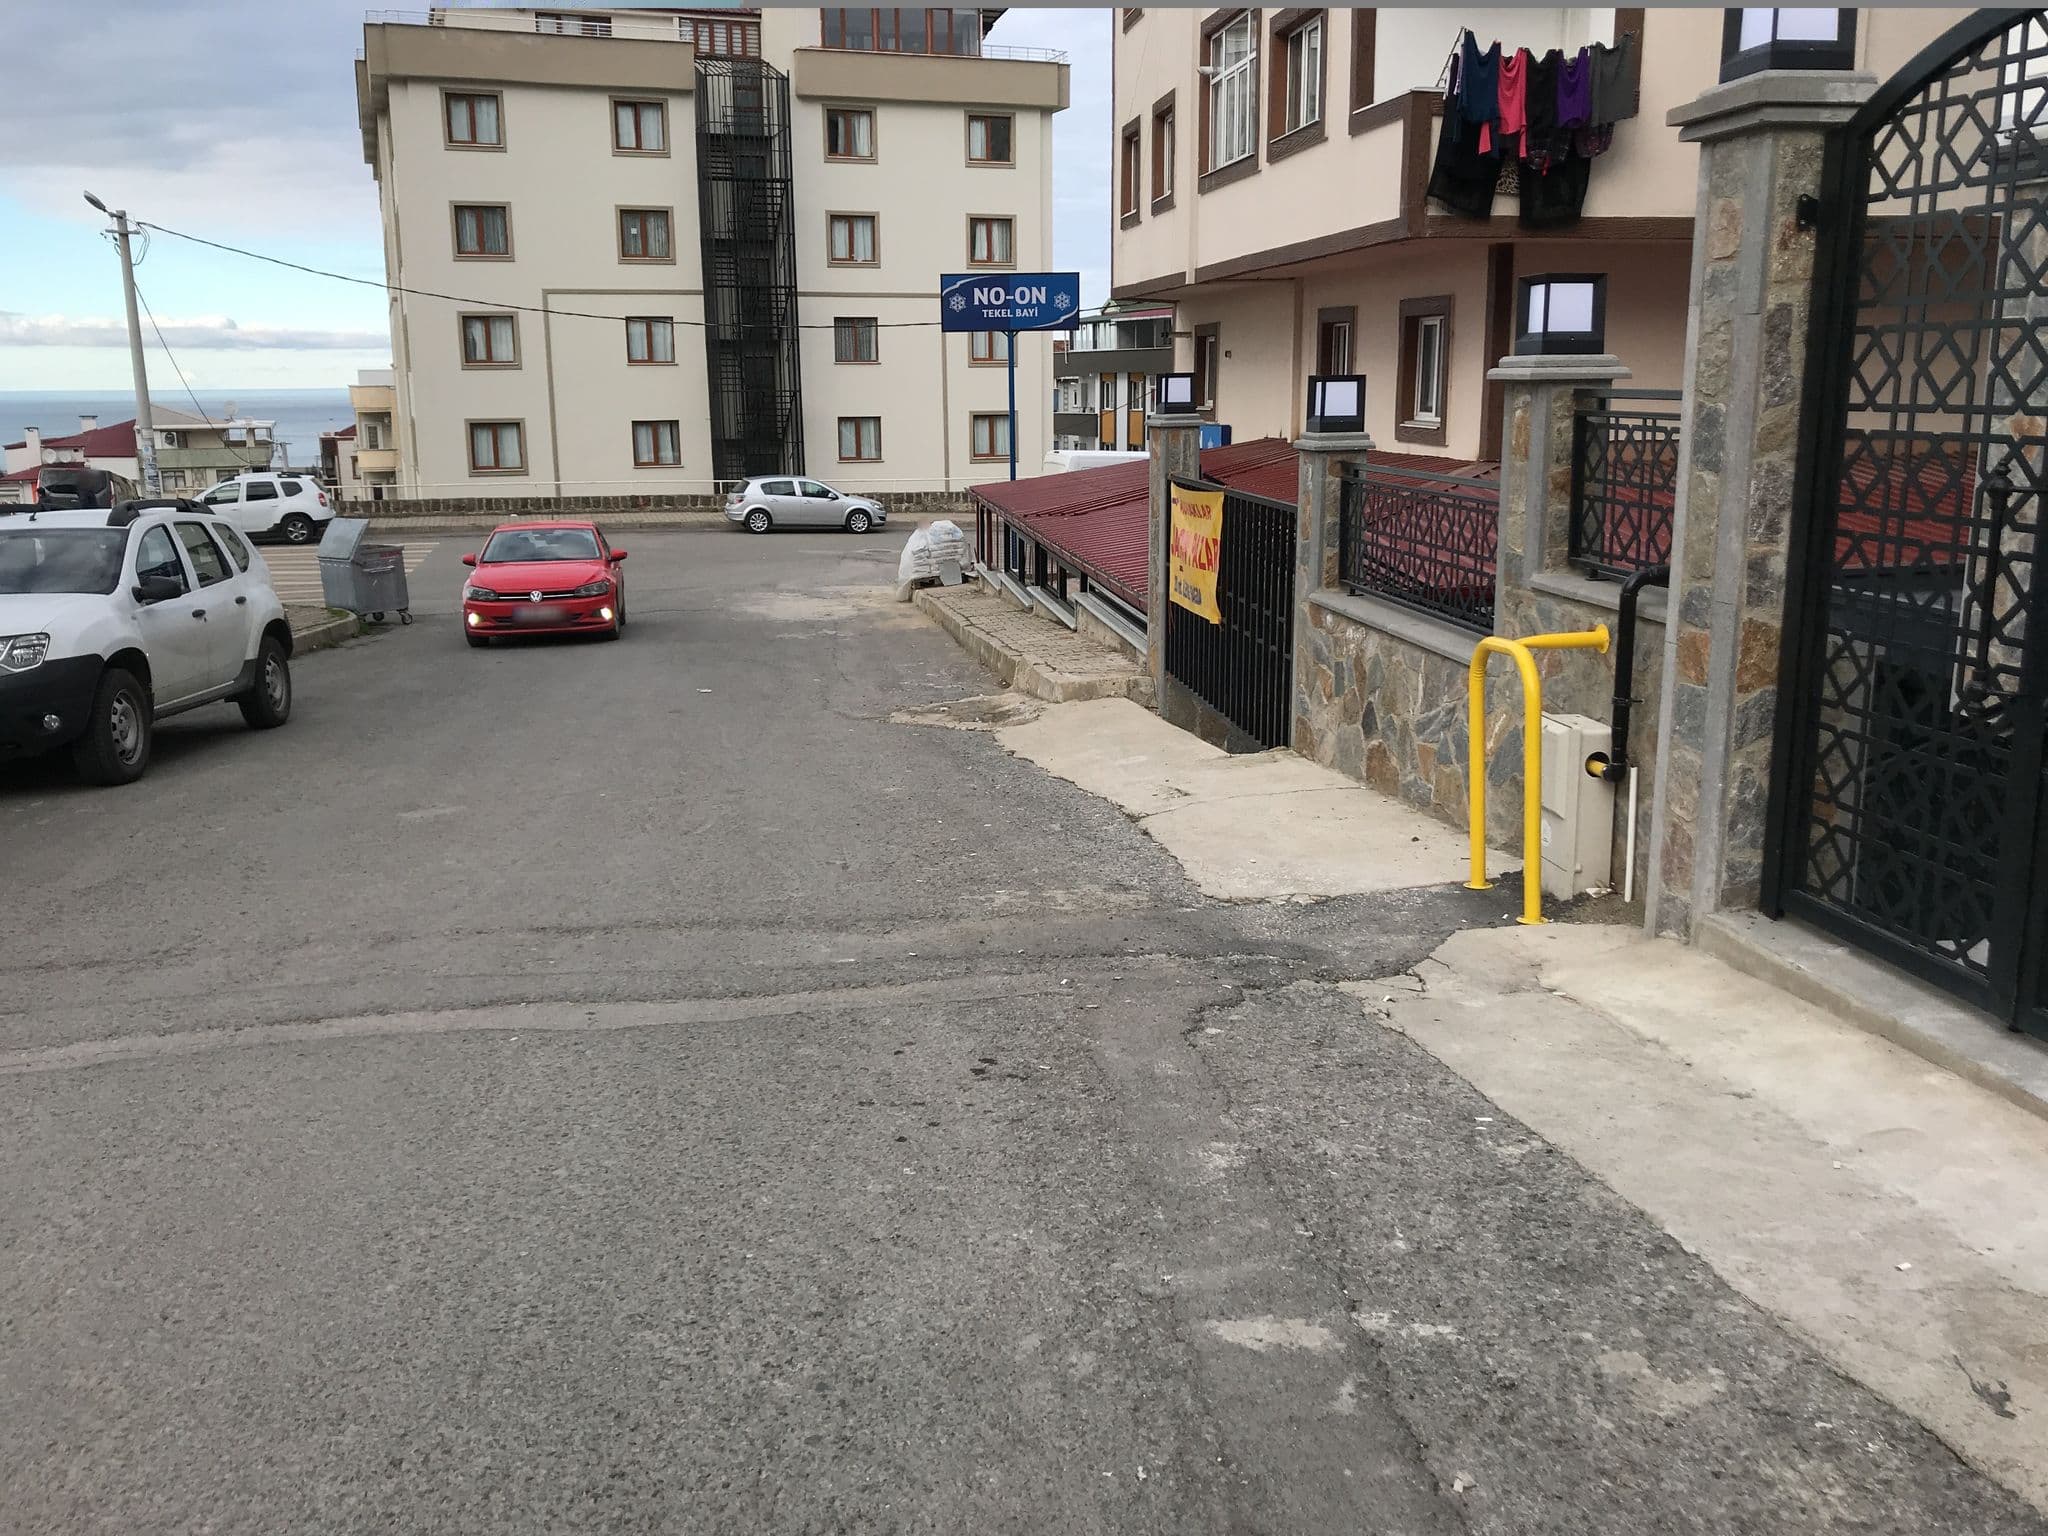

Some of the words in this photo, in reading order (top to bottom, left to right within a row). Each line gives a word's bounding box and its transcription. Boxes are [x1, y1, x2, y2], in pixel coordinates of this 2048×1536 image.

[973, 286, 1047, 306] NO-ON
[982, 308, 1014, 318] TEKEL
[1015, 306, 1039, 318] BAYİ
